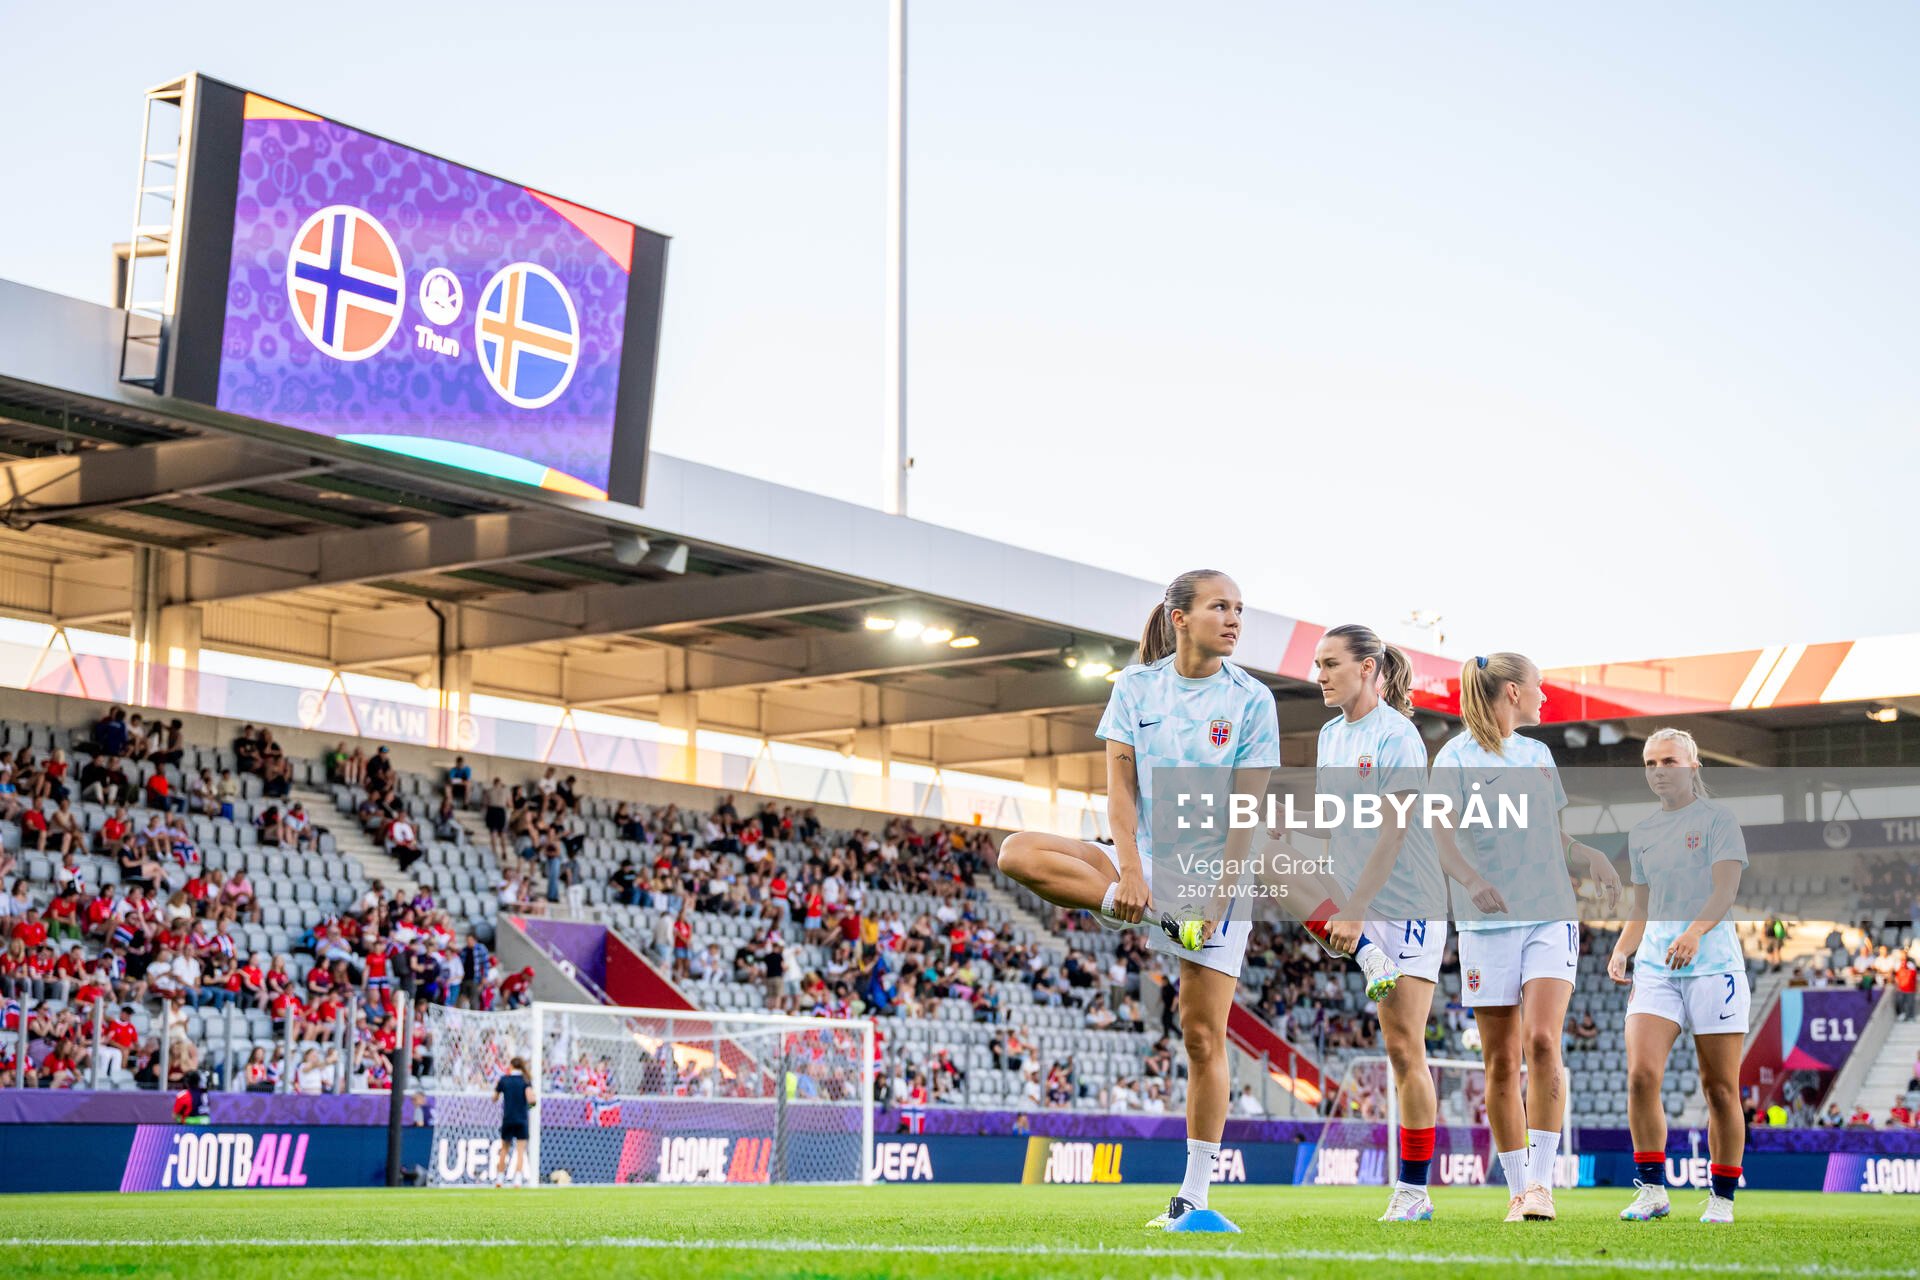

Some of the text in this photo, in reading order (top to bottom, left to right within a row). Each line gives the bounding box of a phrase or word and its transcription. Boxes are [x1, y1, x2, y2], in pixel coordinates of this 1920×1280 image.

[414, 324, 460, 358] Thun
[357, 703, 426, 738] THUN
[1810, 1017, 1857, 1042] E11
[1440, 1153, 1486, 1184] UEFA
